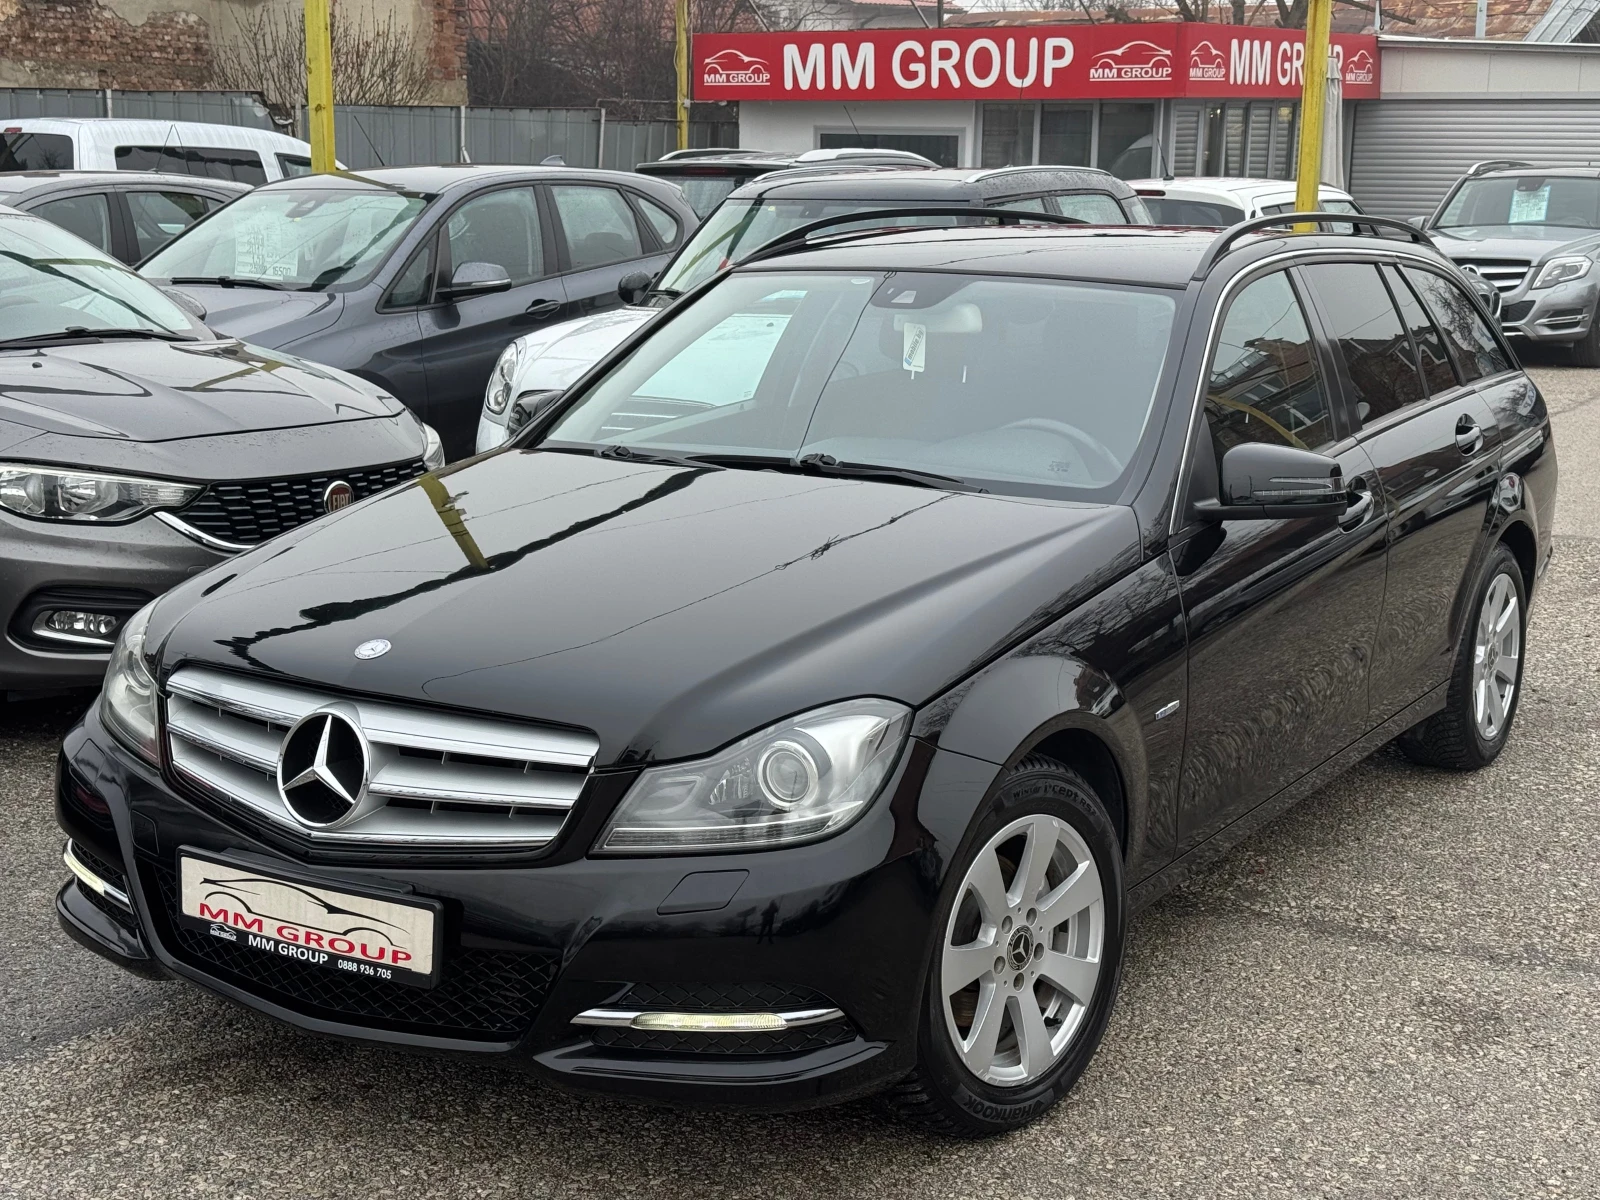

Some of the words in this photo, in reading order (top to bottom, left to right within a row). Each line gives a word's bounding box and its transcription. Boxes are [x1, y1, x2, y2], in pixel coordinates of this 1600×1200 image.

[783, 42, 875, 91] MM
[892, 37, 1074, 90] GROUP
[1089, 68, 1118, 79] MM
[1121, 67, 1172, 78] GROUP
[1189, 68, 1203, 78] MM
[1203, 67, 1226, 78] GROUP
[1229, 38, 1272, 85] MM
[704, 73, 726, 83] MM
[729, 73, 771, 83] GROUP
[332, 493, 350, 511] FIAT
[199, 902, 263, 933] MM
[276, 925, 412, 965] GROUP
[248, 934, 276, 953] MM
[278, 943, 329, 965] GROUP
[337, 959, 358, 972] 0888
[360, 964, 375, 976] 936
[376, 968, 392, 980] 705
